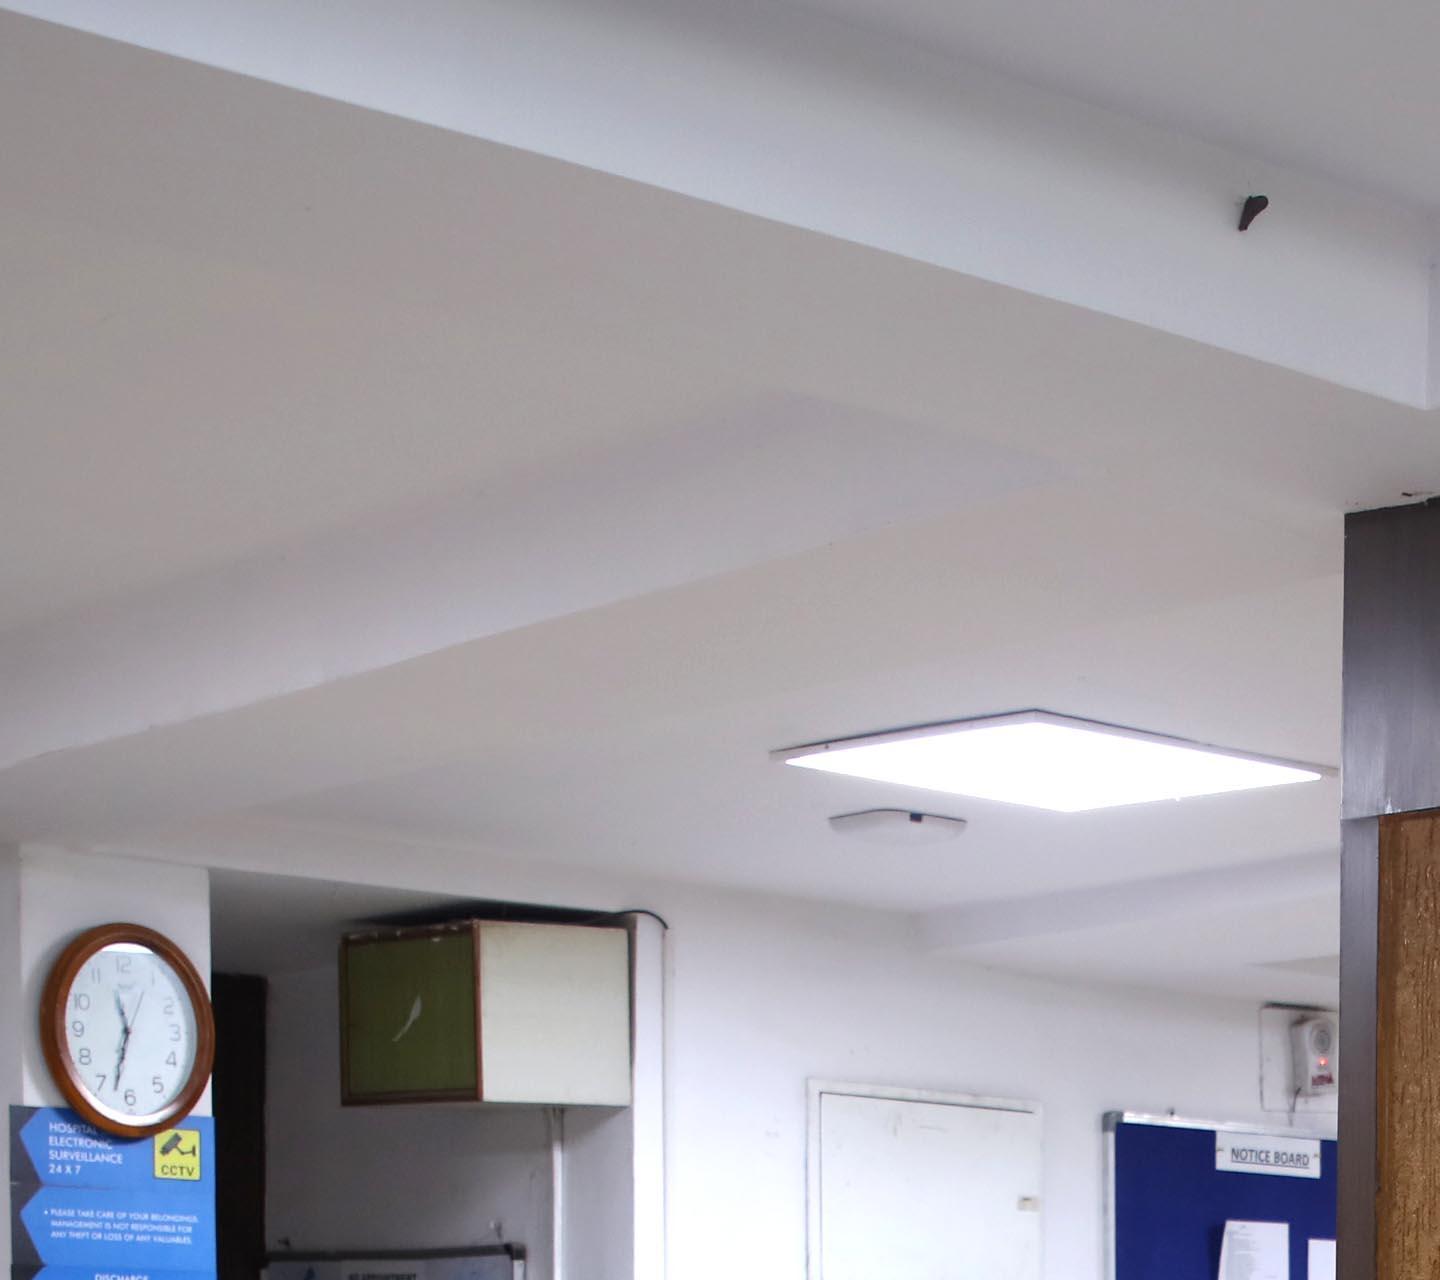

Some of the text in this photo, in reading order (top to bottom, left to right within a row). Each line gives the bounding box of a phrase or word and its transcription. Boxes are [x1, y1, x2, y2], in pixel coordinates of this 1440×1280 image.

[49, 1123, 97, 1135] HOSPITAL
[49, 1152, 123, 1165] SURVEILLANCE
[1232, 1148, 1310, 1166] NOTICE BOARD
[161, 1165, 194, 1176] CCTV
